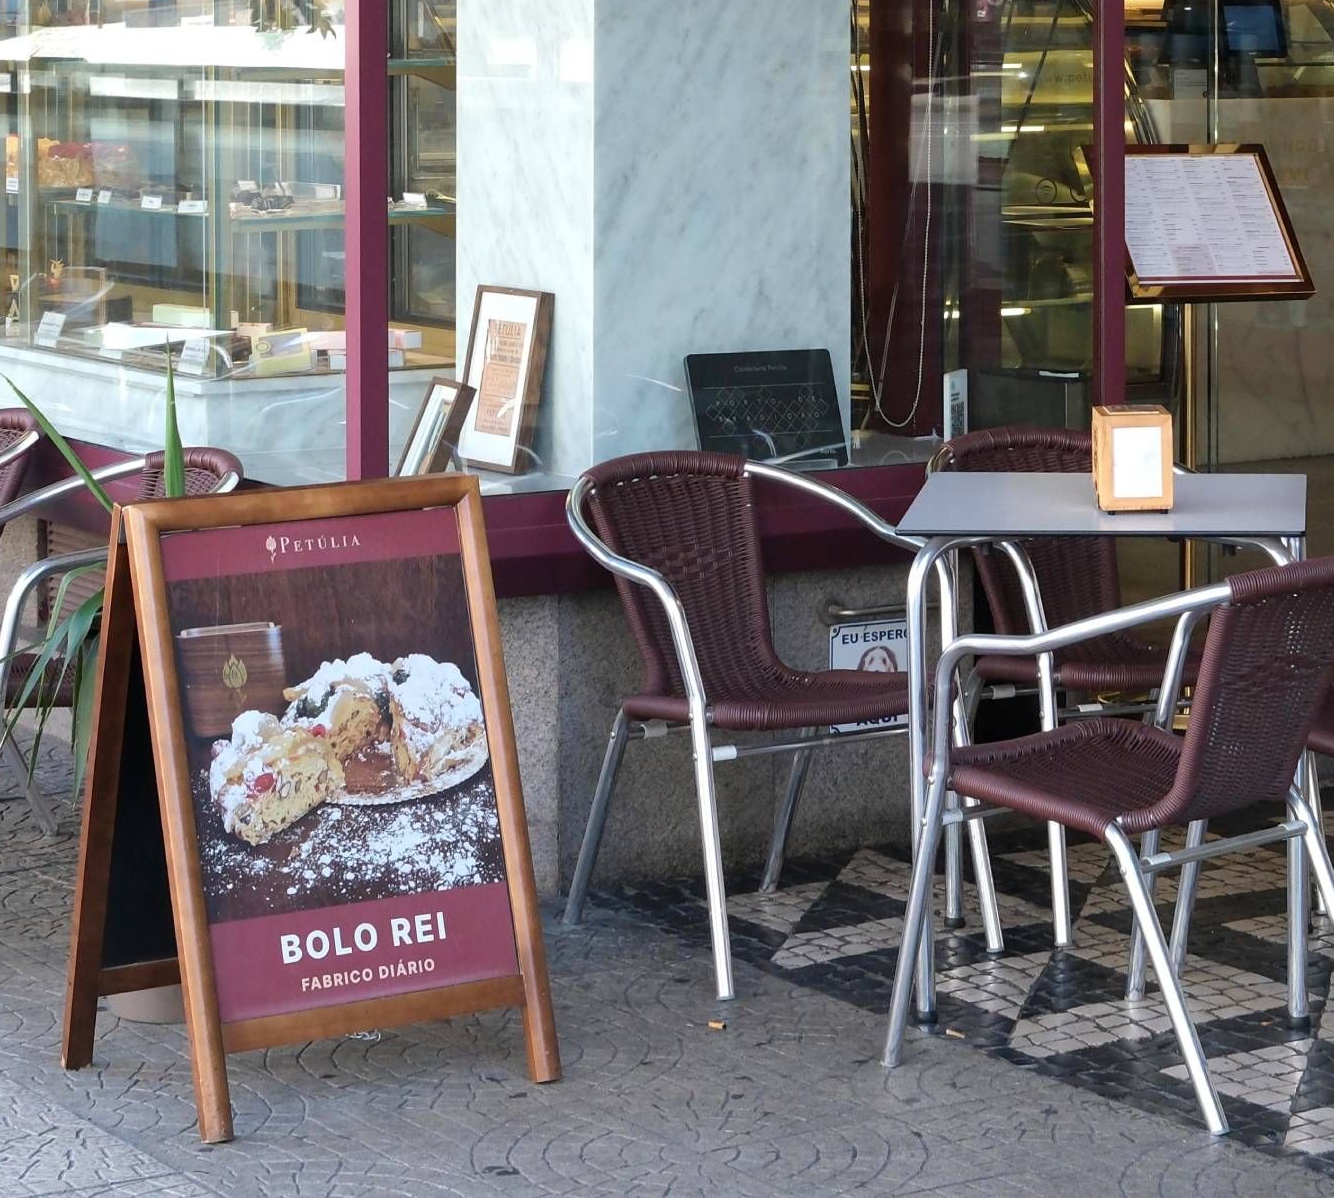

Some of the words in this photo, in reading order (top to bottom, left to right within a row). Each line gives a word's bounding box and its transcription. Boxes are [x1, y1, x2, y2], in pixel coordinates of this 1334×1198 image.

[279, 533, 361, 555] PETÚLIA
[842, 632, 859, 644] EU
[279, 919, 379, 965] BOLO
[391, 910, 448, 949] REI
[300, 968, 374, 993] FABRICO
[379, 955, 436, 980] DIÁRIO
